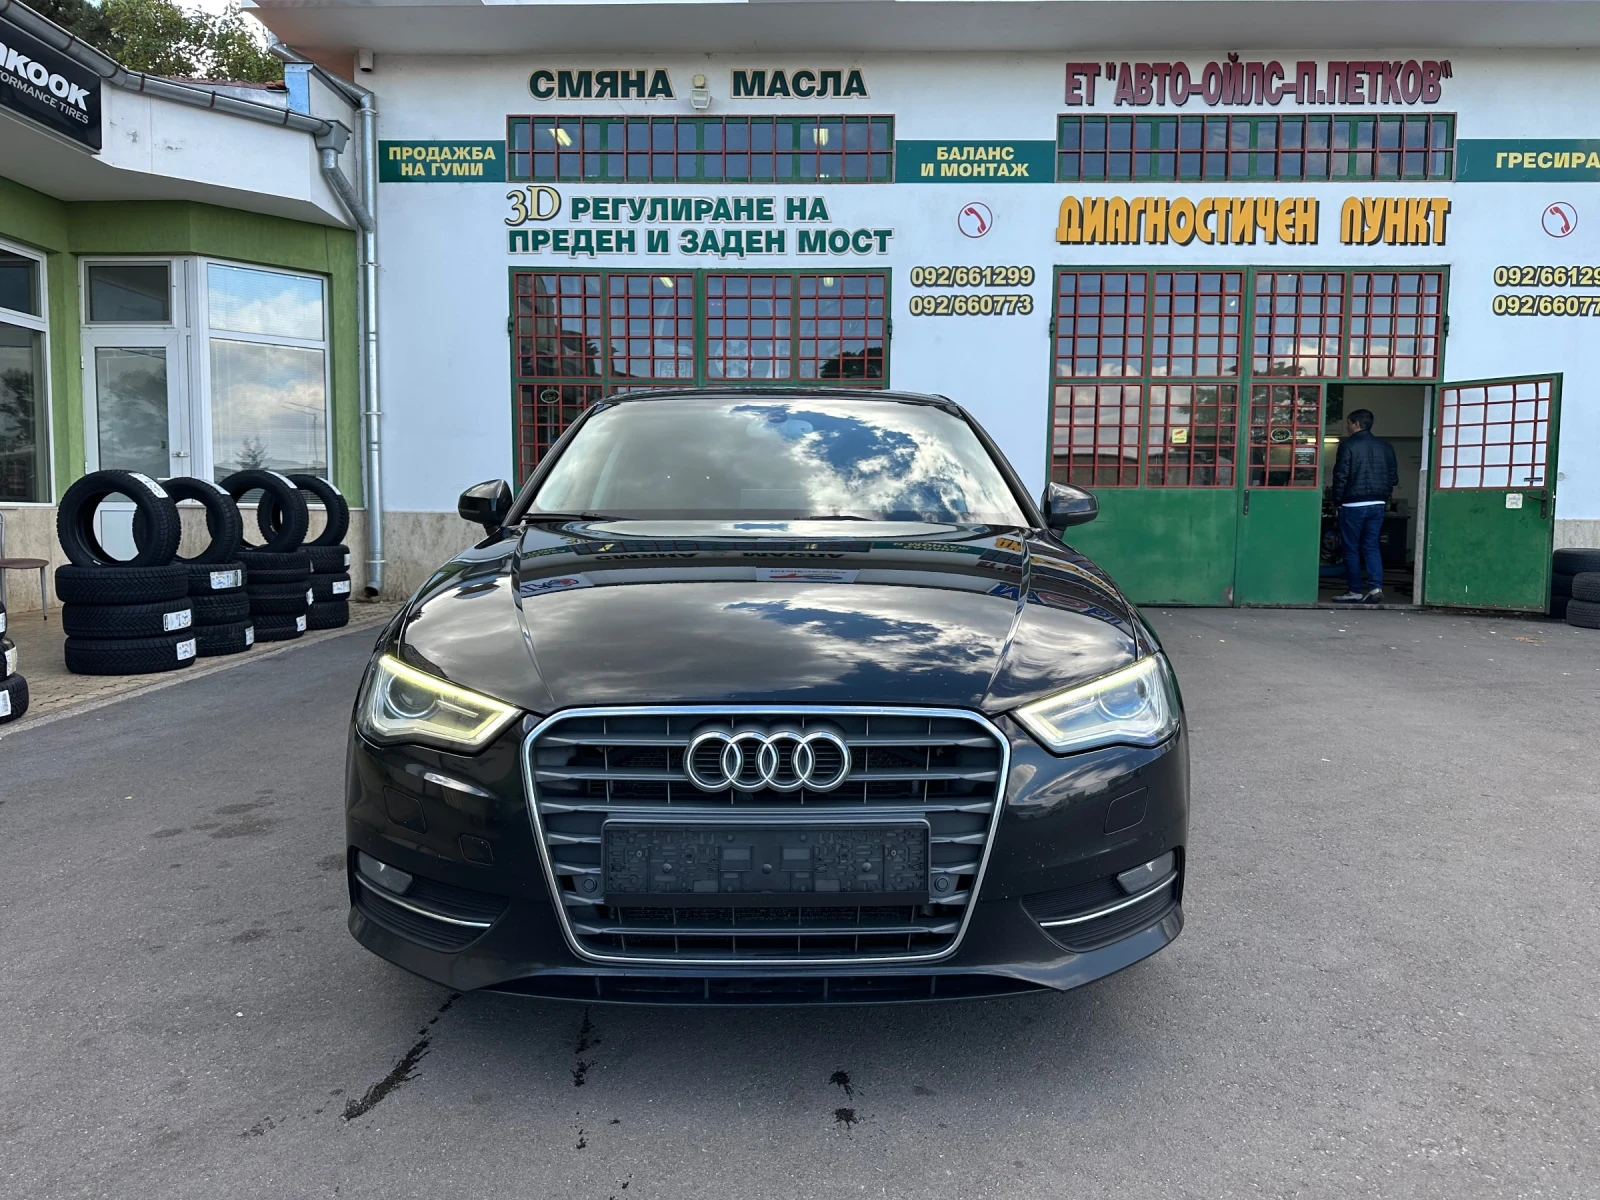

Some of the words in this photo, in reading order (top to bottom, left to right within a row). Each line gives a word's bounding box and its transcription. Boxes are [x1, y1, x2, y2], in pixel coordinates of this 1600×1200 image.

[527, 68, 676, 101] СМЯНА
[730, 68, 871, 100] МАСЛА
[1064, 62, 1100, 107] ЕТ
[0, 70, 58, 108] ORMANCE
[59, 101, 89, 124] TIRES
[388, 147, 496, 162] ПРОДАЖБА
[936, 147, 1014, 161] БАЛАНС
[1496, 152, 1600, 168] ГРЕСИРА
[401, 163, 426, 176] НА
[431, 163, 483, 176] ГУМИ
[920, 163, 934, 177] И
[940, 163, 1029, 177] МОНТАЖ
[504, 185, 562, 227] 3D
[569, 196, 777, 223] РЕГУЛИРАНЕ
[784, 196, 832, 223] НА
[1055, 195, 1320, 246] ДИАГНОСТИЧЕН
[1340, 195, 1452, 246] ПУНКТ
[507, 228, 638, 259] ПРЕДЕН
[645, 228, 671, 255] И
[678, 228, 787, 260] ЗАДЕН
[796, 228, 894, 255] МОСТ
[910, 265, 1035, 288] 092/661299
[909, 294, 1034, 317] 092/660773
